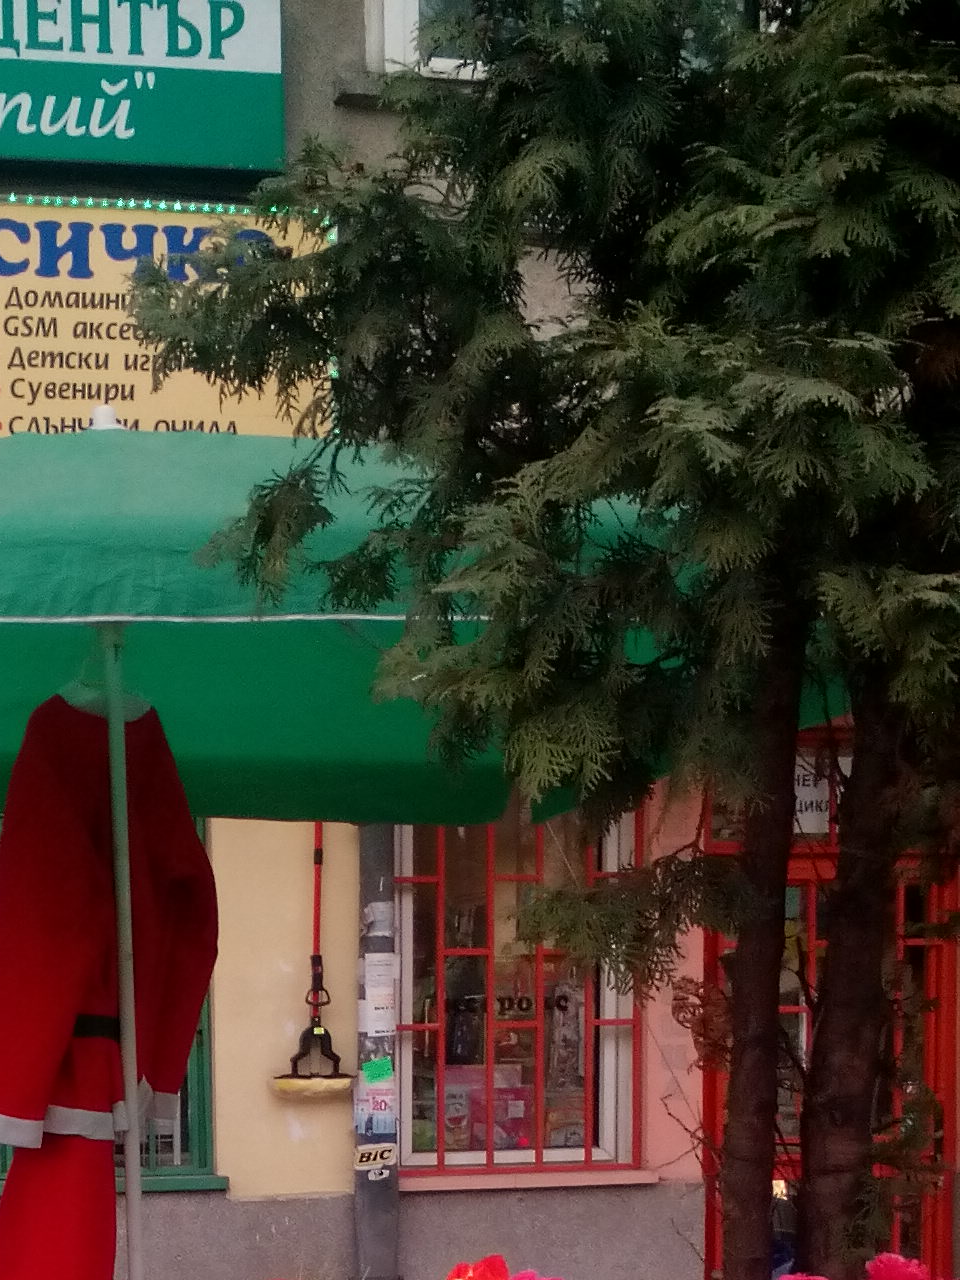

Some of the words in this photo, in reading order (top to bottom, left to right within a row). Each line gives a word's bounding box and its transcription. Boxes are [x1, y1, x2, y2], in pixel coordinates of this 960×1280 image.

[3, 315, 59, 339] GSM
[7, 346, 110, 372] Детски
[9, 378, 136, 406] Сувенири
[359, 1149, 392, 1163] BIC
